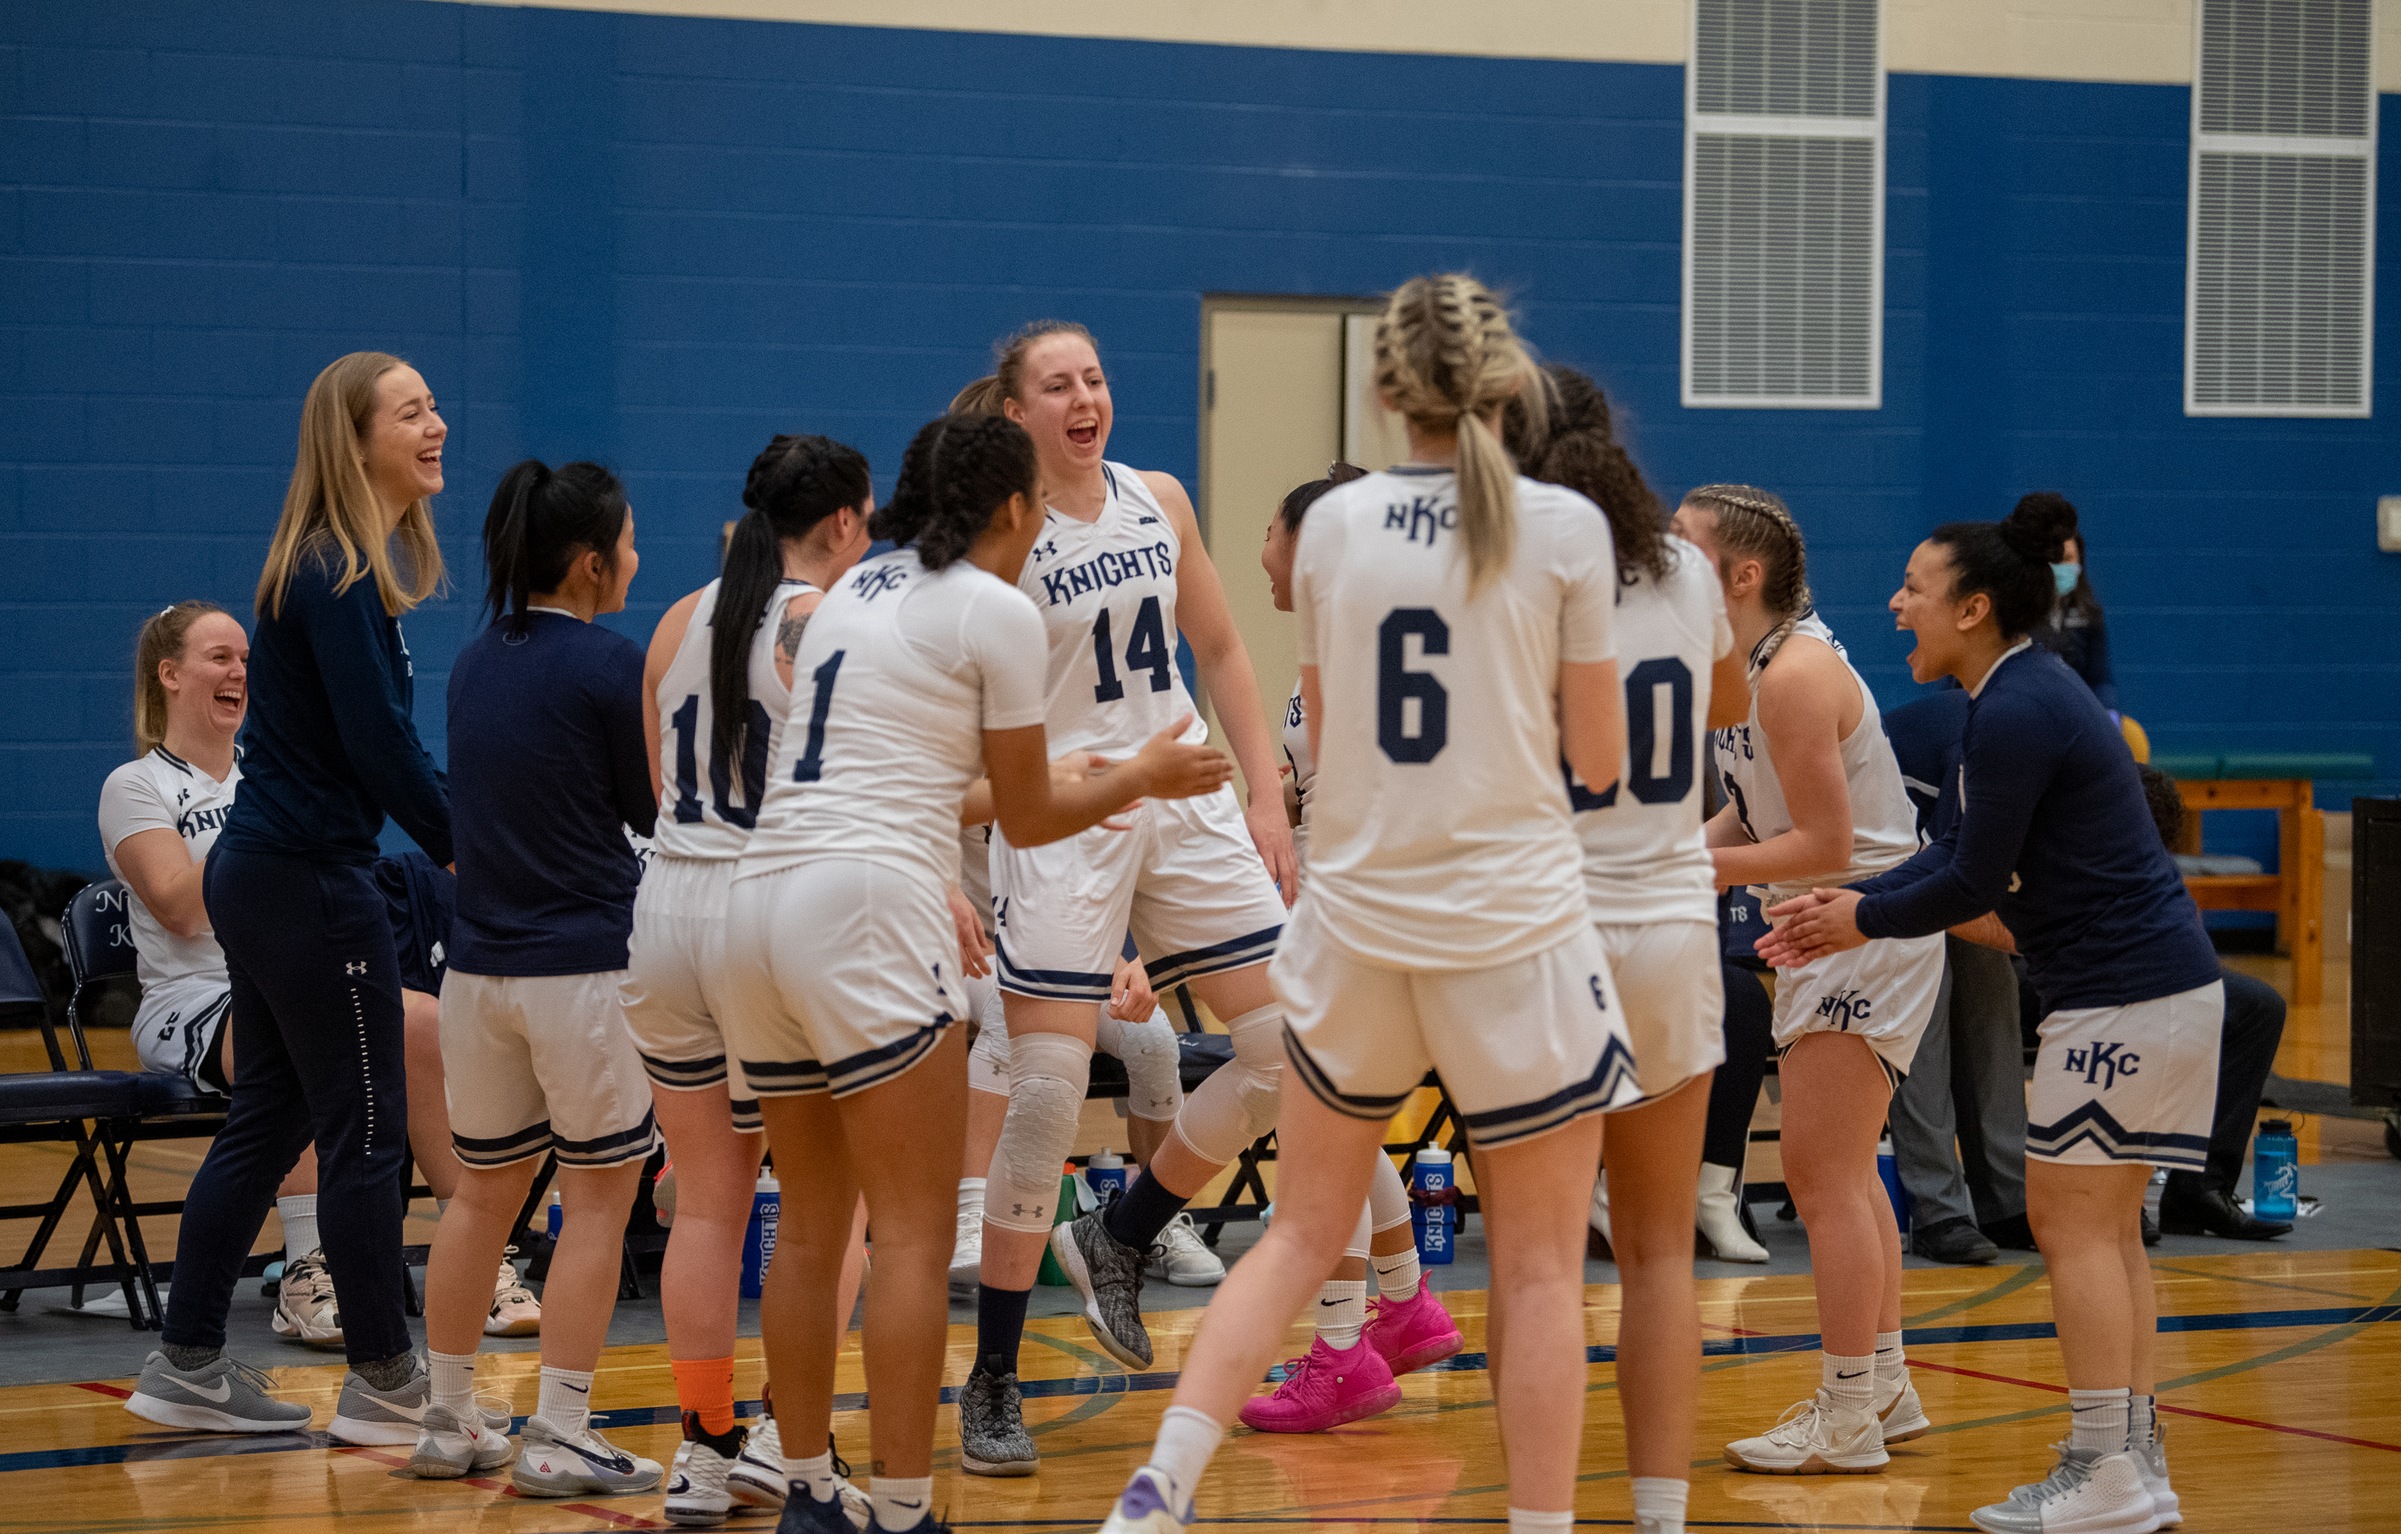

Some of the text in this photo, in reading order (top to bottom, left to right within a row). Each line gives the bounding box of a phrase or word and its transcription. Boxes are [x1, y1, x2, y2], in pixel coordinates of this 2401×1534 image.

[850, 564, 906, 603] NKC
[1040, 541, 1172, 606] KNIGHTS
[1091, 595, 1172, 703] 14
[1378, 608, 1450, 764] 6
[792, 650, 846, 782] 1
[671, 694, 771, 829] 10
[1815, 990, 1871, 1032] NKC
[2063, 1041, 2140, 1091] NKC
